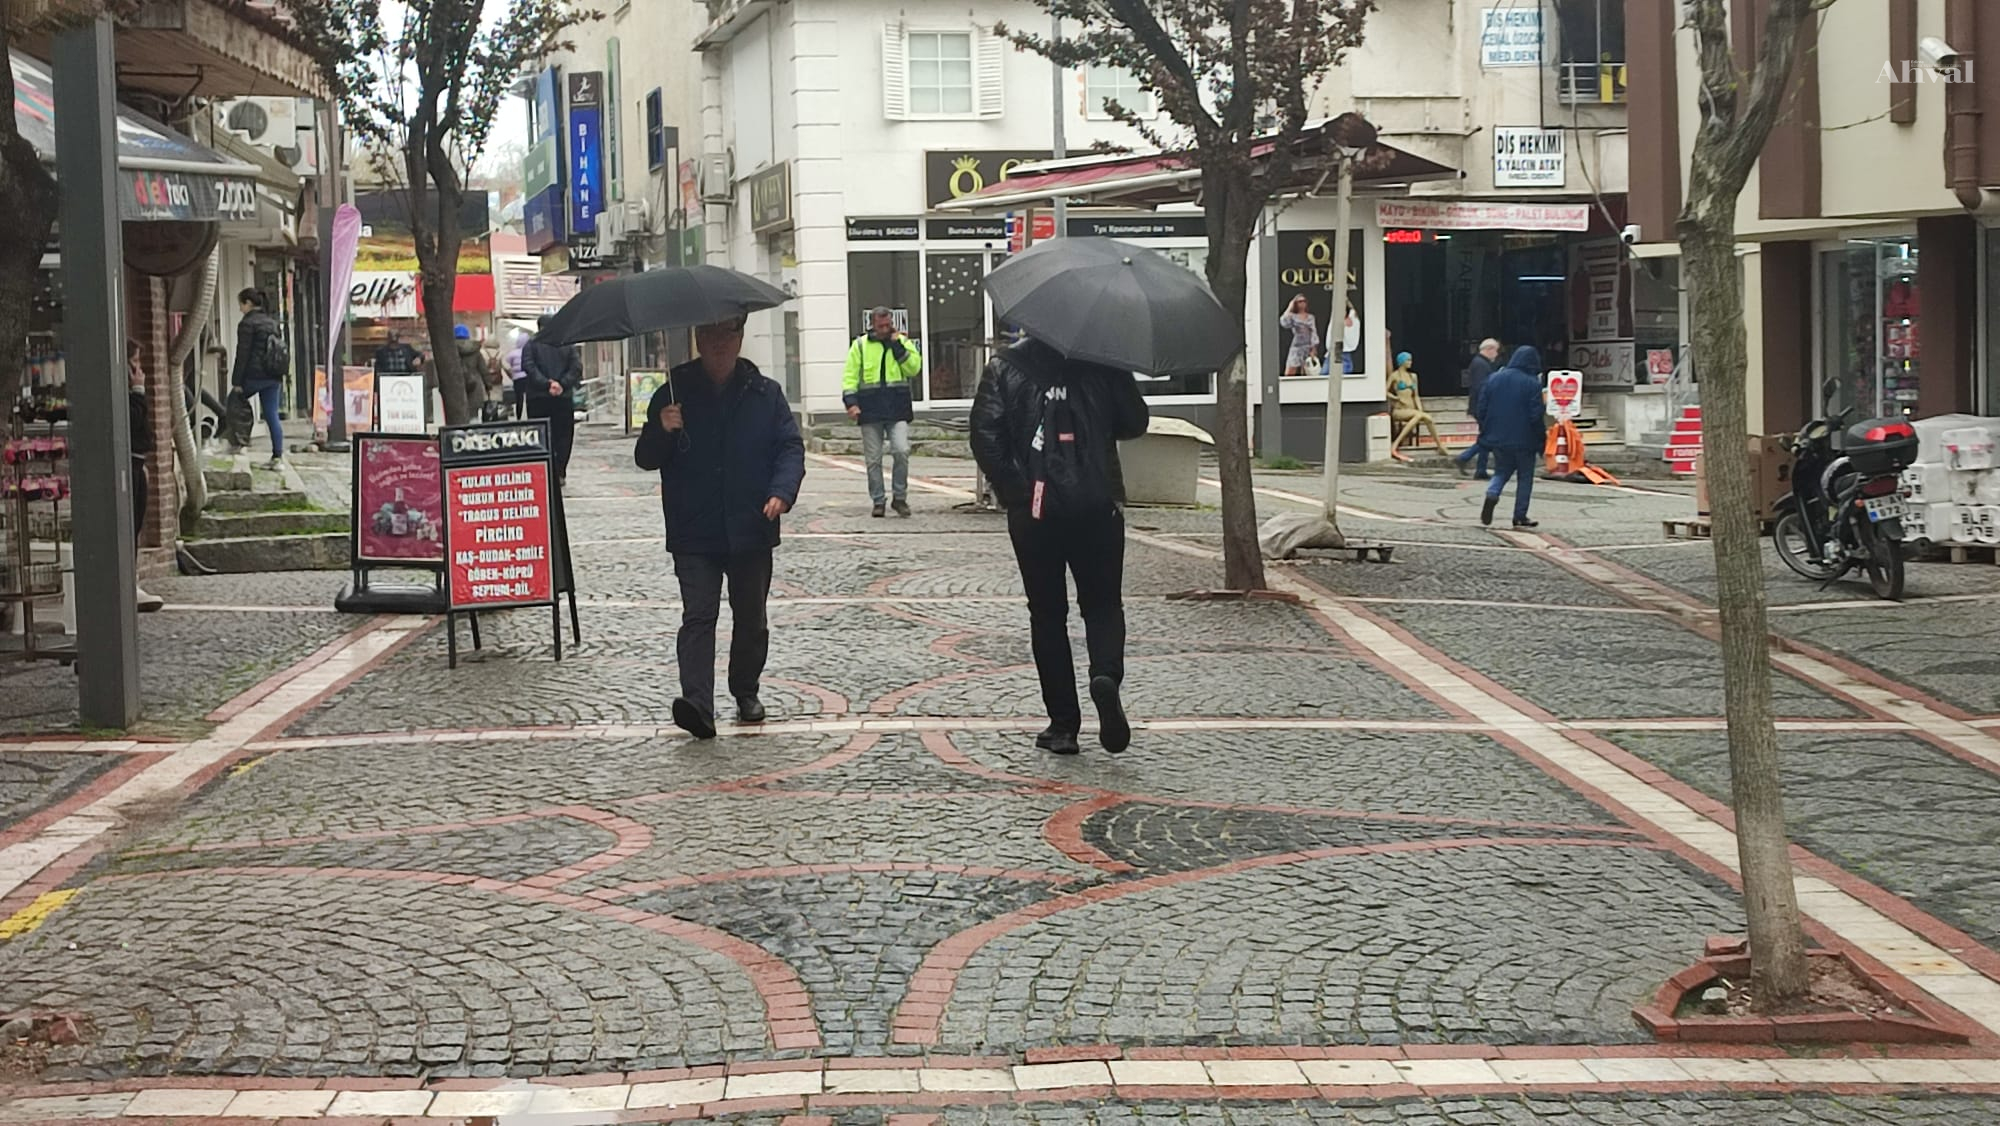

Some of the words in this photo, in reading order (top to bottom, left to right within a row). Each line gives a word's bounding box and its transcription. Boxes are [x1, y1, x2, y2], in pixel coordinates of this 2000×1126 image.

[1519, 131, 1562, 154] HEKİMİ
[578, 123, 590, 219] BİHANE
[1539, 159, 1562, 171] ATAY
[214, 177, 256, 220] zippo
[497, 487, 535, 503] DELİNİR
[502, 504, 540, 520] DELİNİR
